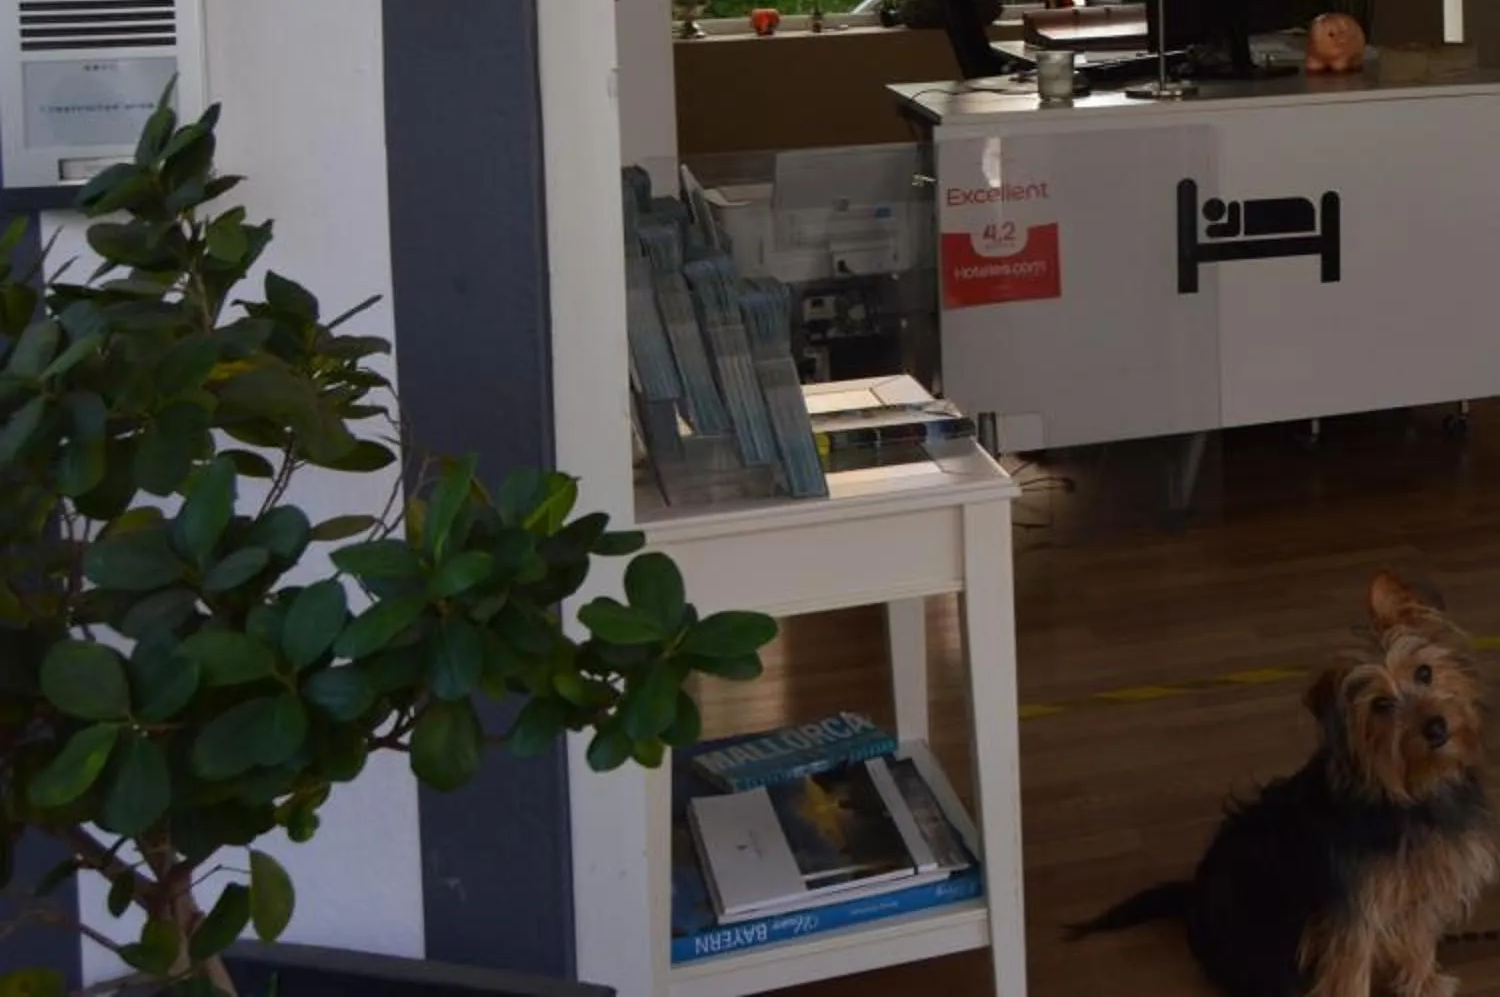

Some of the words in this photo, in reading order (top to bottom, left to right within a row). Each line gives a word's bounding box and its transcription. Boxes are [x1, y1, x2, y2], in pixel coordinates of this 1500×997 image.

[947, 182, 1050, 206] Excellent
[693, 711, 878, 772] MALLORCA
[695, 923, 768, 954] BAYERN
